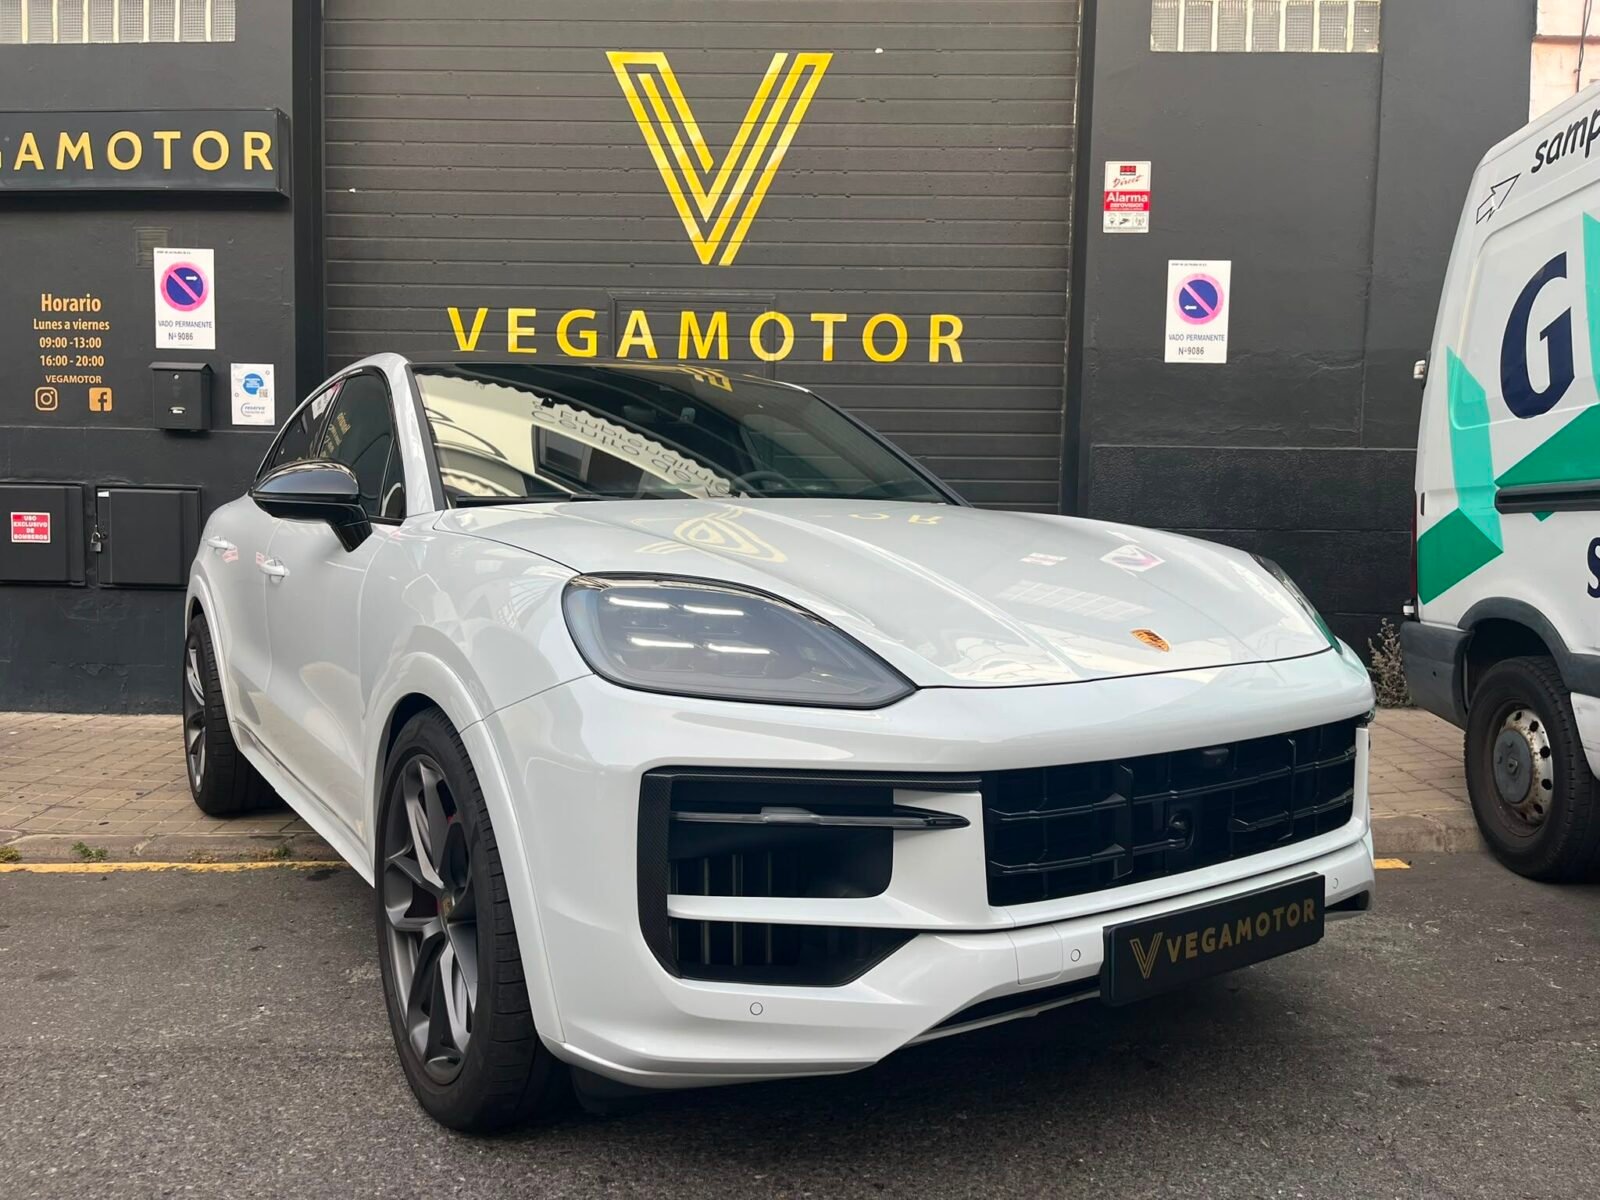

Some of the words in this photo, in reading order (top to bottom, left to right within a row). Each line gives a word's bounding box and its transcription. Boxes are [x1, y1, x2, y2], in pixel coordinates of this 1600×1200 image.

[0, 130, 274, 171] AMOTOR
[1106, 191, 1149, 203] Alarma
[41, 293, 102, 312] Horario
[33, 318, 62, 330] Lunes
[64, 321, 71, 330] a
[73, 318, 110, 330] viernes
[158, 320, 174, 328] VADO
[175, 320, 213, 329] PERMANENTE
[447, 307, 965, 364] VEGAMOTOR
[1186, 334, 1226, 342] PERMANENTE
[1500, 251, 1575, 419] G
[40, 337, 67, 348] 09:00
[40, 355, 68, 367] 16:00
[76, 355, 105, 367] 20:00
[45, 375, 102, 384] VEGAMOTOR
[1167, 898, 1316, 963] VEGAMOTOR
